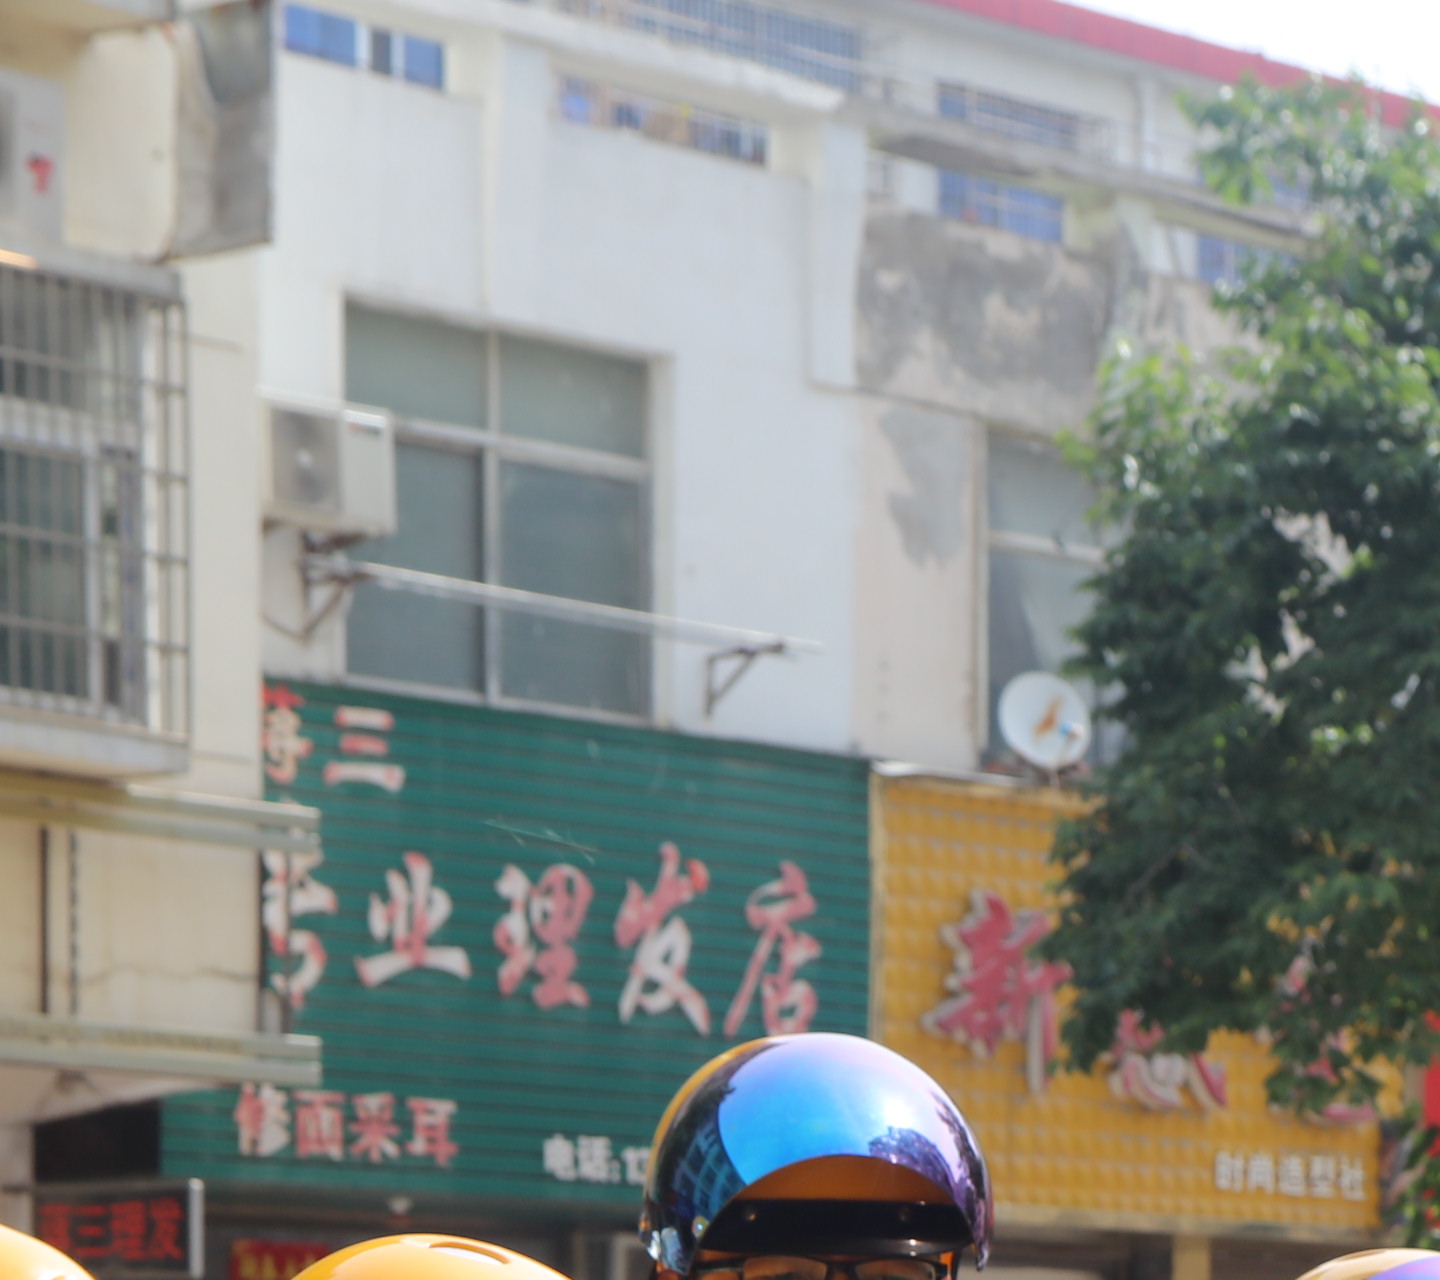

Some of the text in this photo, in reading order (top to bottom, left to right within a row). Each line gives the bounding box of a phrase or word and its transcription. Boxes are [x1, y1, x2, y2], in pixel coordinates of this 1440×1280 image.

[234, 1081, 458, 1166] 修面采耳
[1214, 1150, 1367, 1201] 时尚造型社
